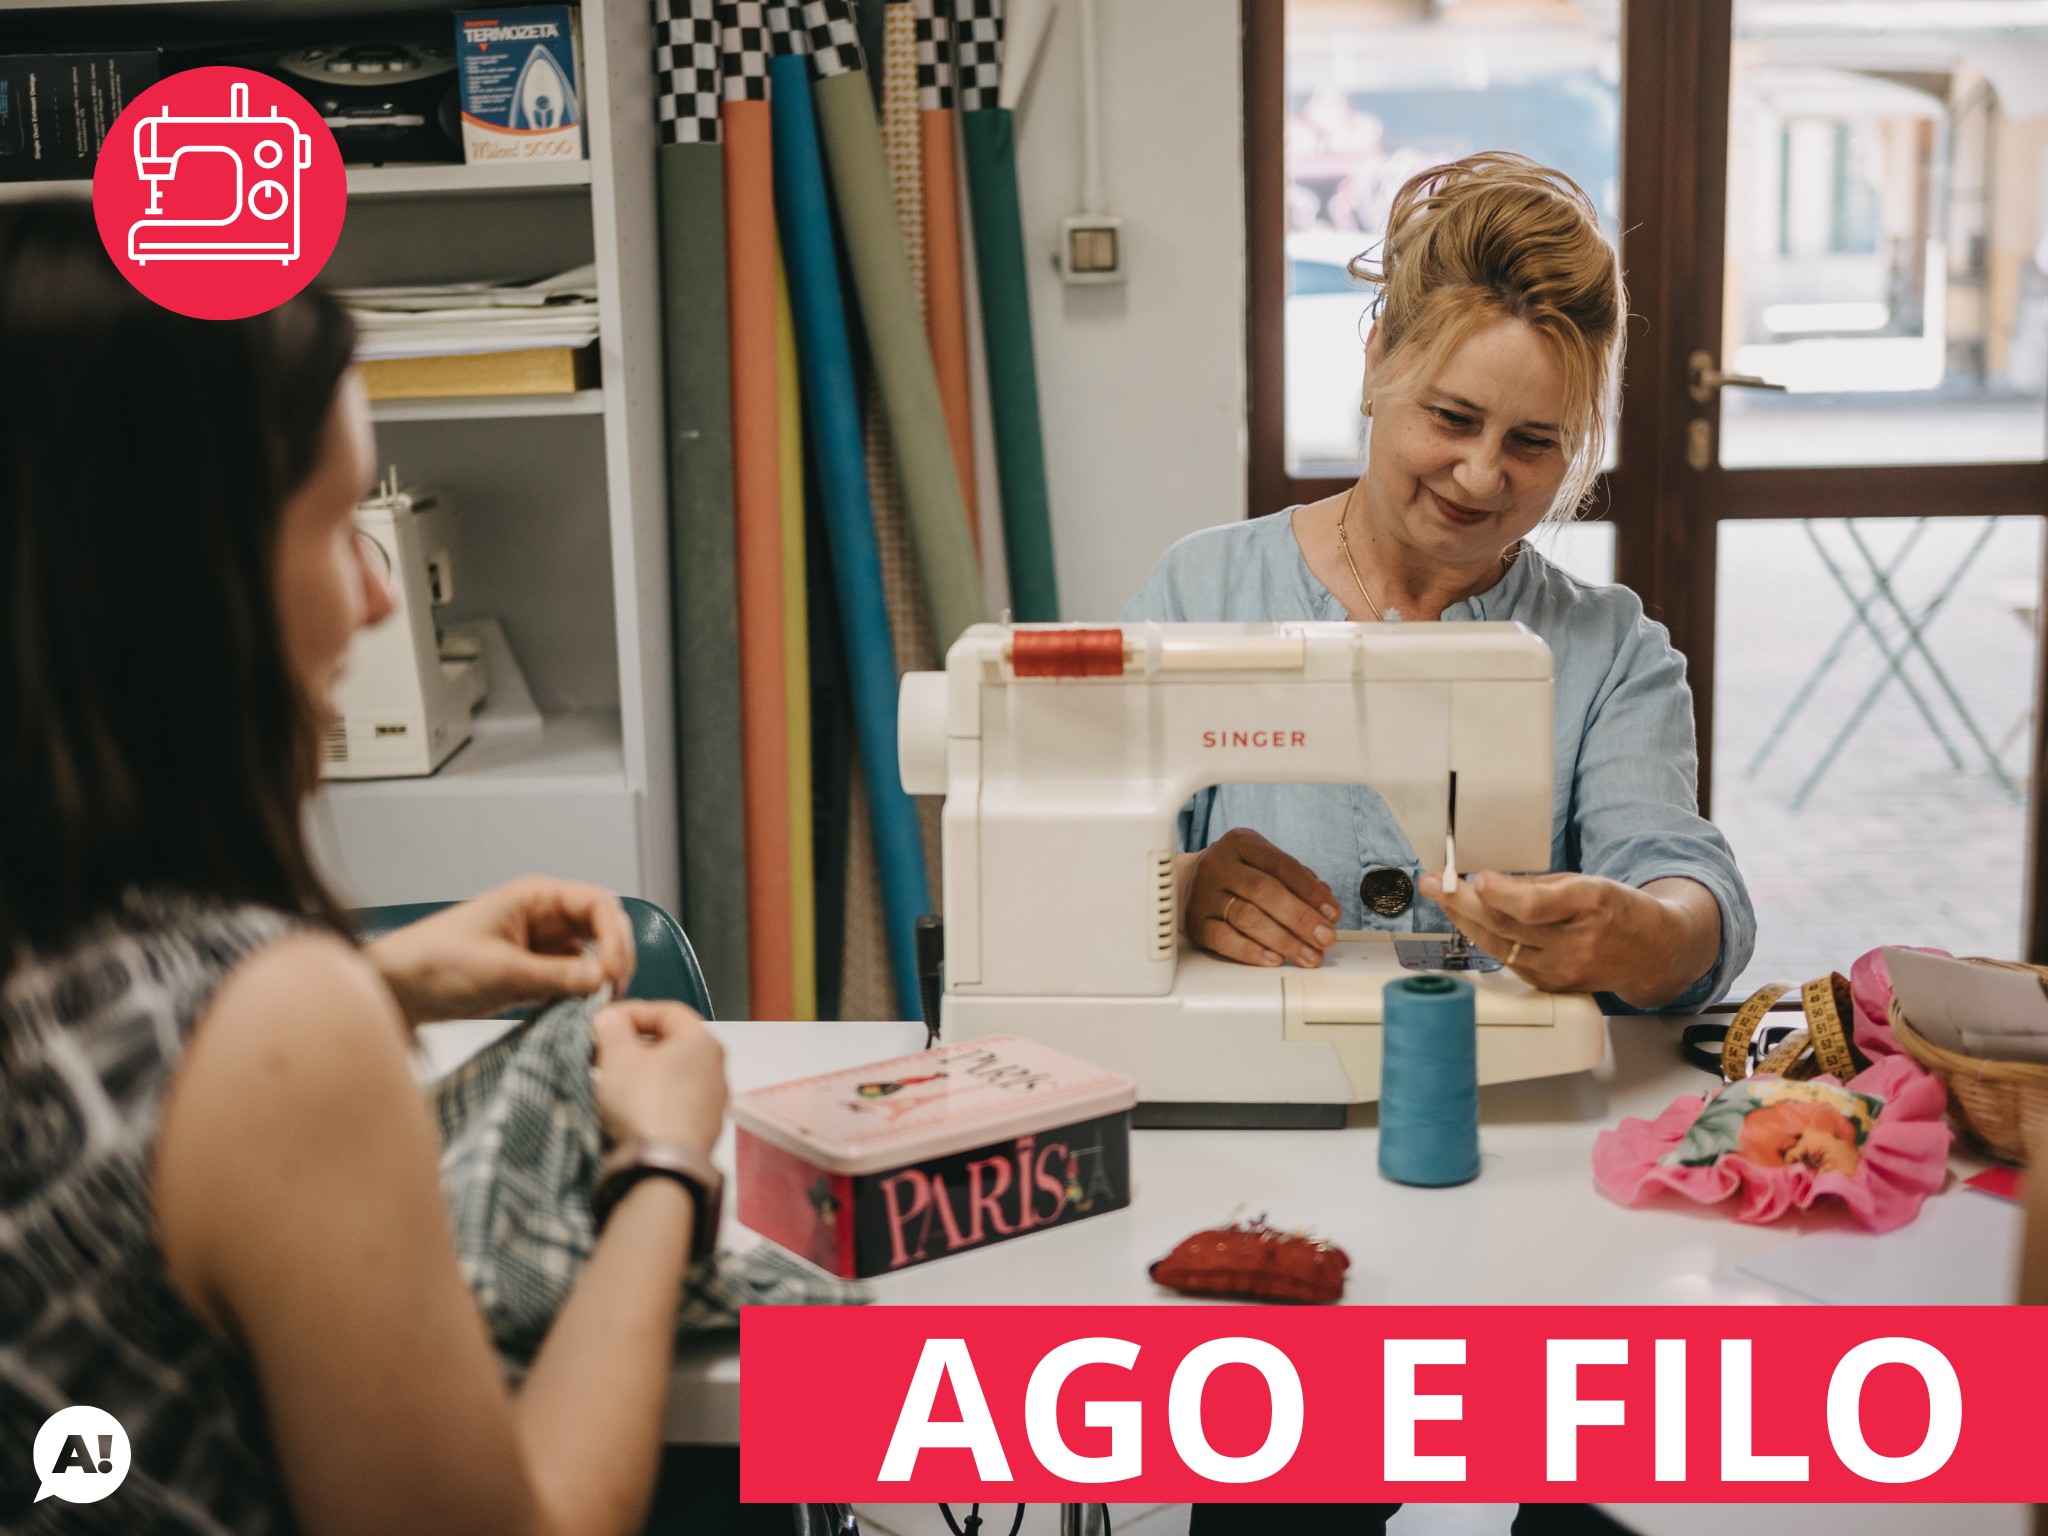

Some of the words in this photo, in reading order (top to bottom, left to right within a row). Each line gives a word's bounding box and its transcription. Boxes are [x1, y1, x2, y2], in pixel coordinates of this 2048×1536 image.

[463, 23, 560, 43] TERMOZETA
[1203, 731, 1307, 748] SINGER
[1811, 1007, 1824, 1018] 50
[1820, 1038, 1833, 1051] 52
[880, 1135, 1068, 1267] PARIS
